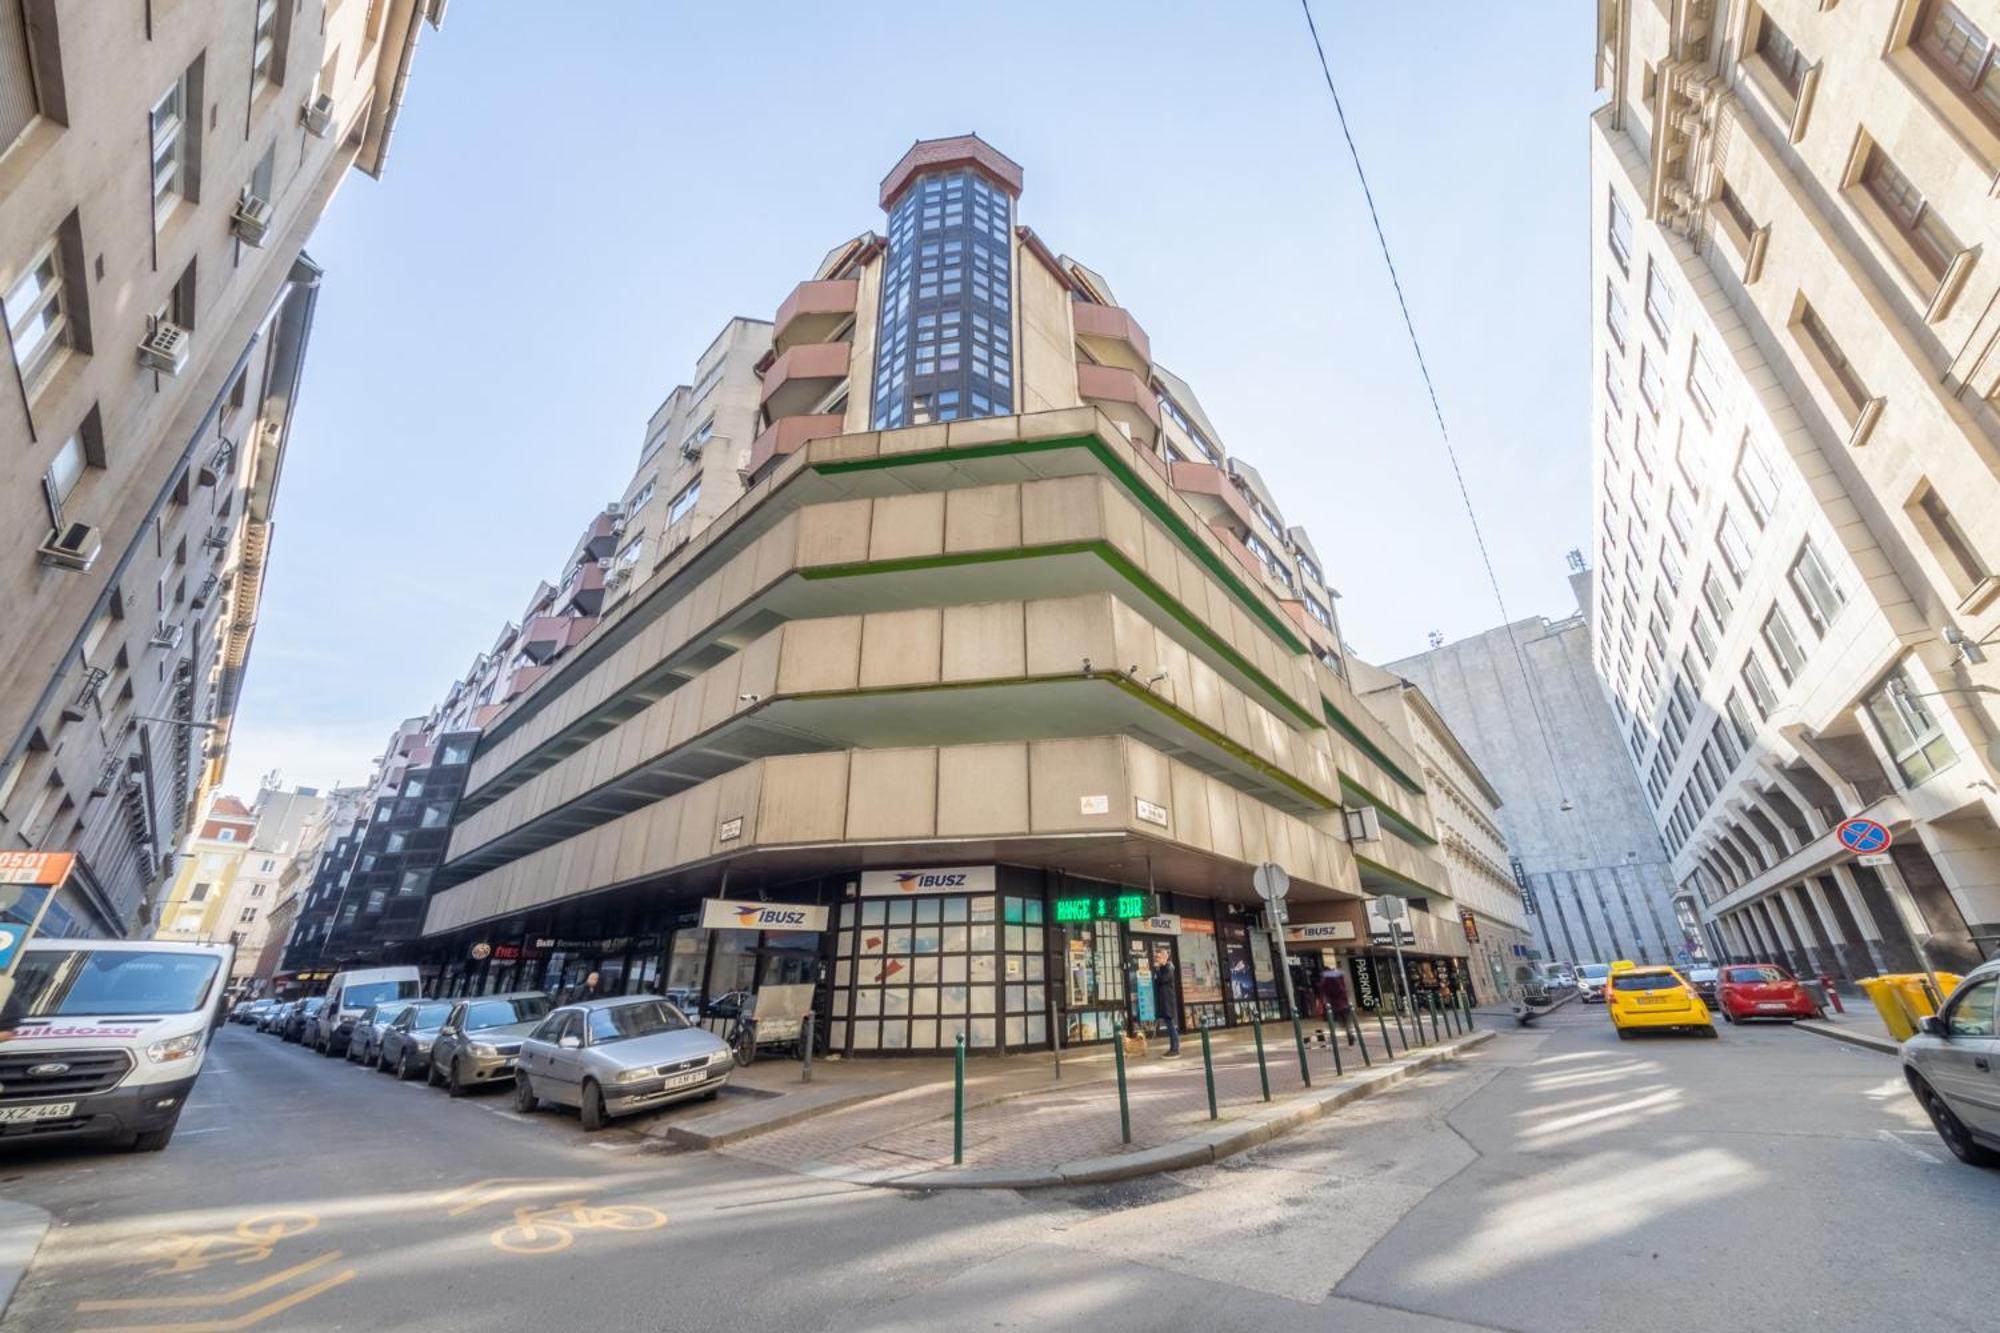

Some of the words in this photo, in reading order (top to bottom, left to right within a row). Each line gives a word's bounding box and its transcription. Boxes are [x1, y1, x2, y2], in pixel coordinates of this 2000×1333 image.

[918, 874, 967, 887] IBUSZ
[1119, 896, 1142, 918] EUR
[758, 911, 807, 924] IBUSZ
[1304, 926, 1336, 936] IBUSZ
[1355, 958, 1375, 1007] PARKING
